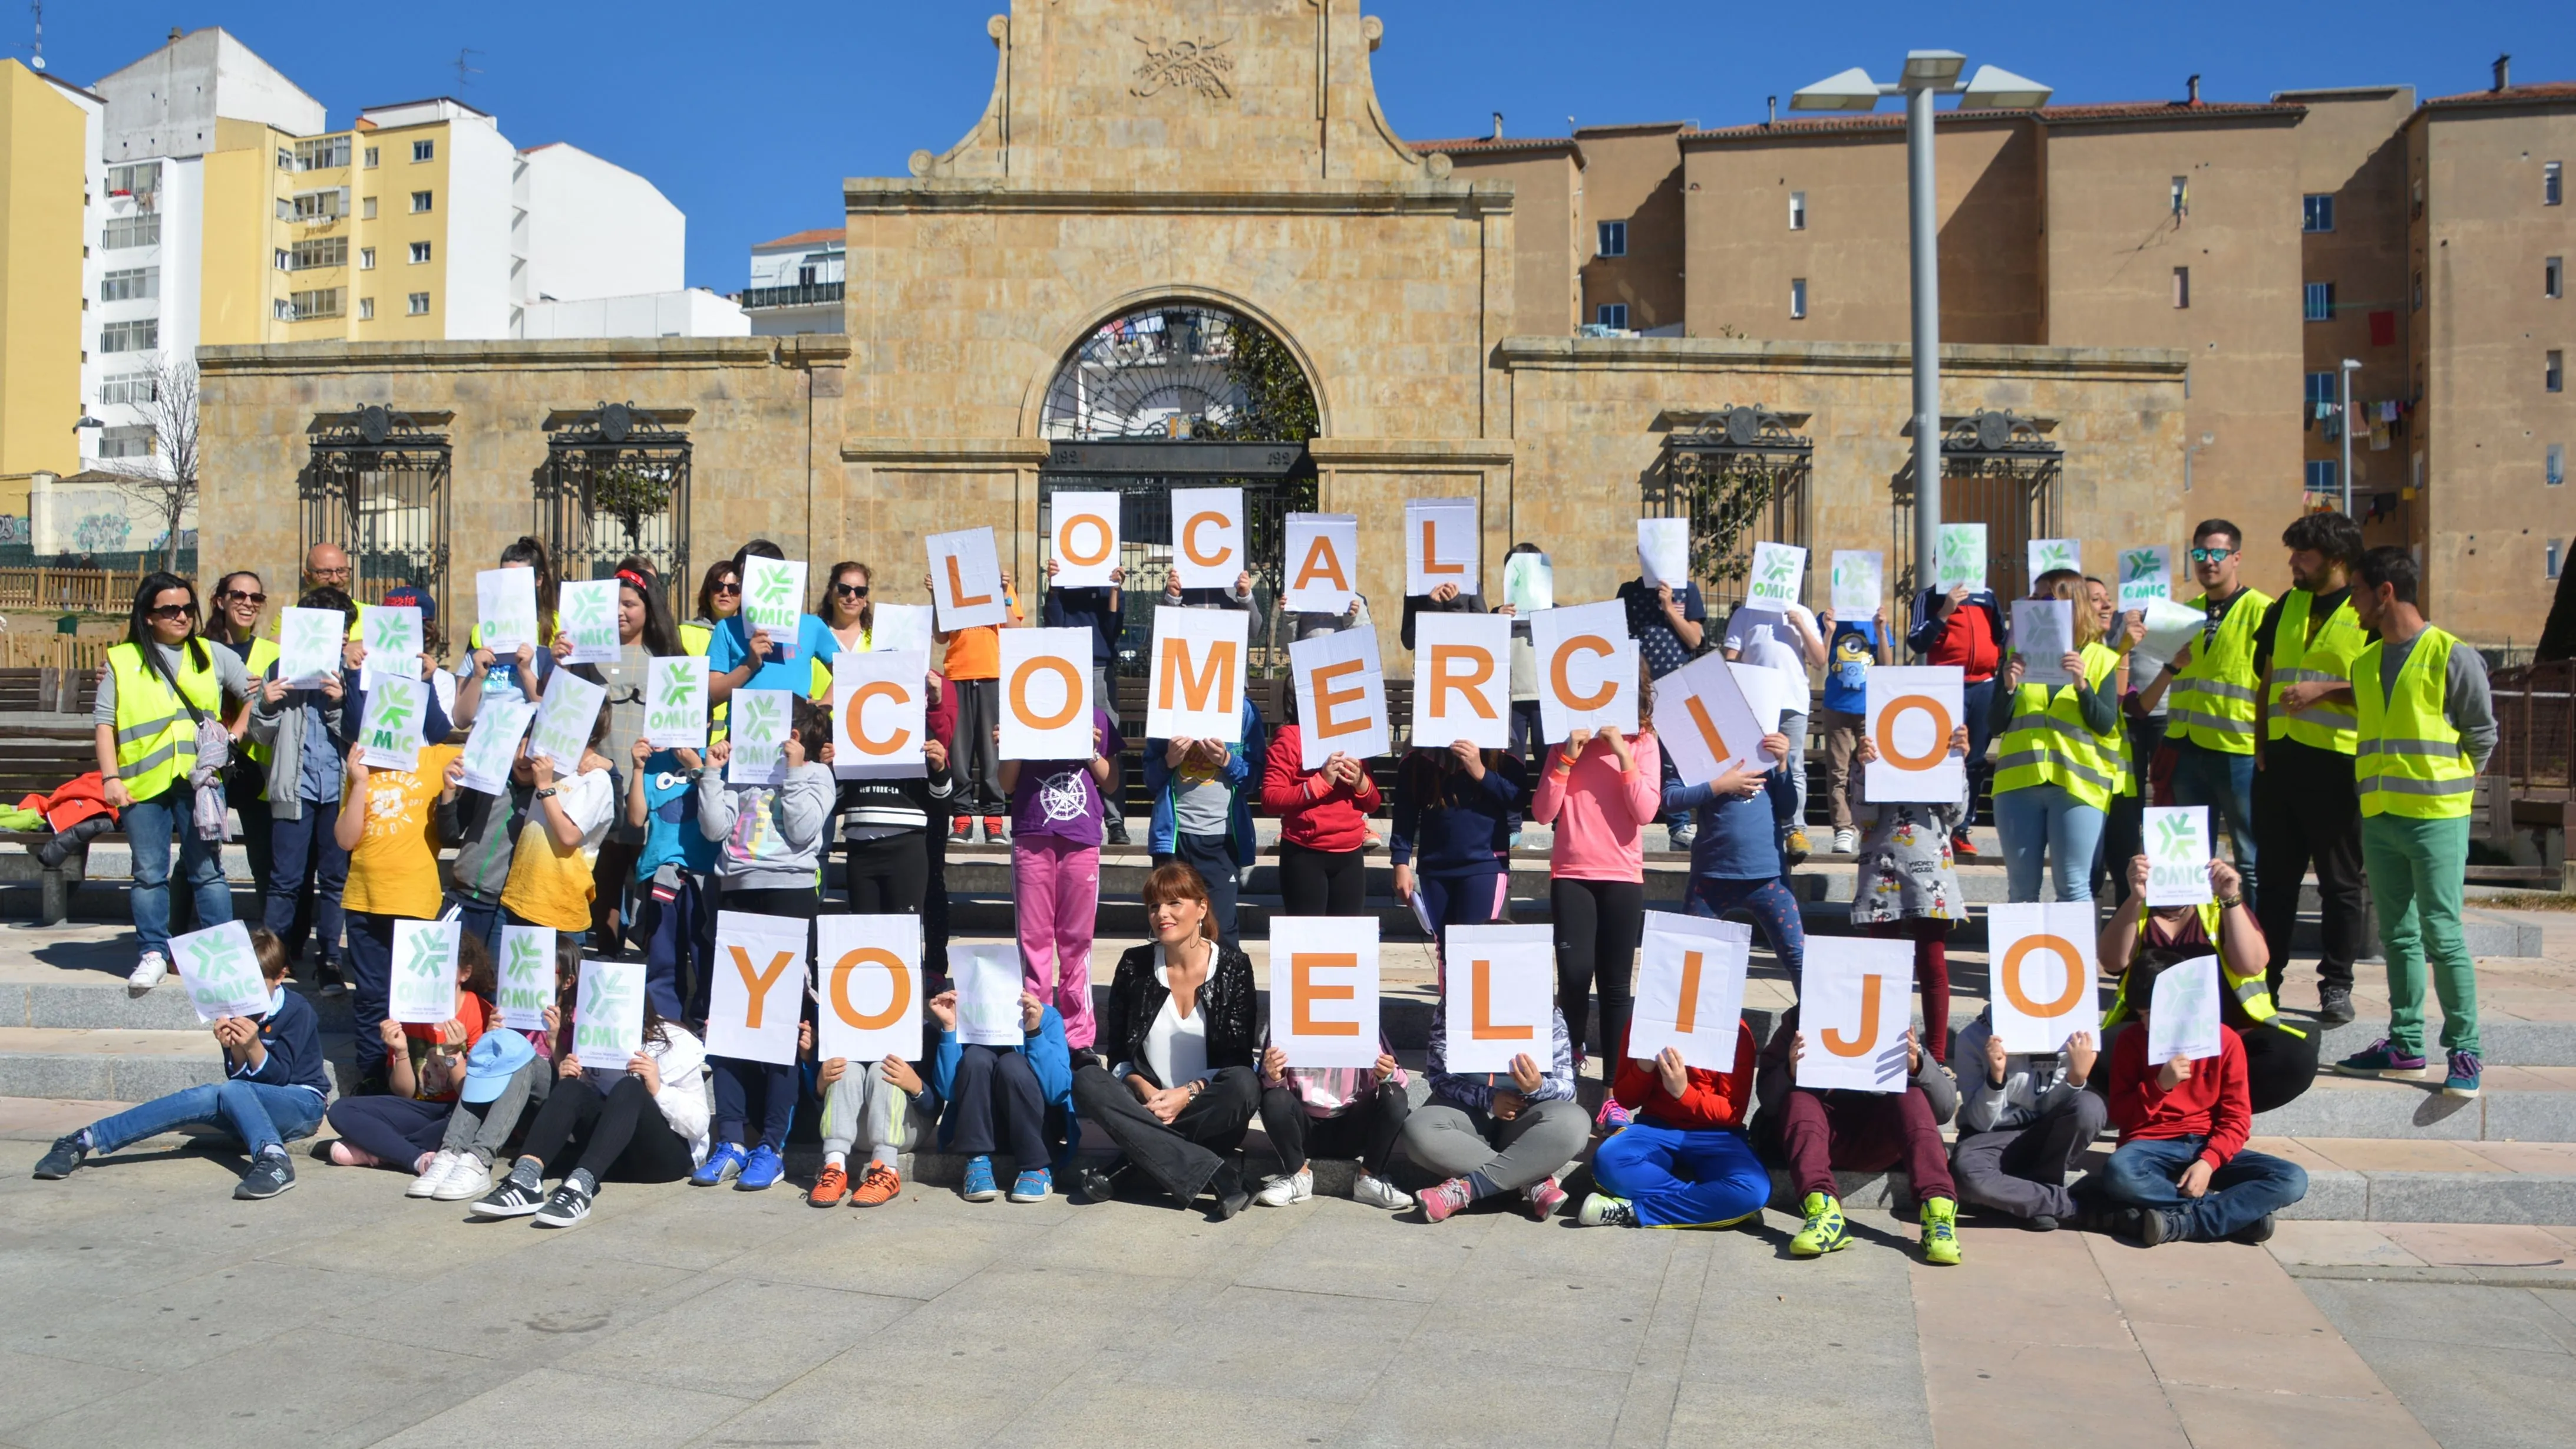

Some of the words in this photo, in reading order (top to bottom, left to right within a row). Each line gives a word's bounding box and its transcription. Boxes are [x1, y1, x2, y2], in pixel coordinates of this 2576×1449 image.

[1059, 513, 1113, 566] O
[1183, 511, 1232, 567] C
[1293, 535, 1349, 590] A
[1422, 520, 1464, 574] L
[946, 555, 992, 608] L
[1752, 582, 1795, 600] OMIC
[2123, 583, 2166, 599] OMIC
[745, 605, 795, 628] OMIC
[1009, 656, 1083, 730] O
[1158, 637, 1237, 714] M
[1311, 659, 1372, 739] E
[1429, 645, 1498, 719] R
[1550, 635, 1619, 711] C
[359, 727, 414, 754] OMIC
[649, 708, 701, 730] OMIC
[846, 681, 911, 755] C
[1685, 694, 1730, 763] I
[1876, 695, 1952, 771] O
[374, 770, 423, 791] LEAGUE
[196, 975, 260, 1005] OMIC
[397, 980, 450, 1004] OMIC
[500, 986, 549, 1011] OMIC
[728, 946, 795, 1029] Y
[830, 948, 911, 1030] O
[1292, 953, 1359, 1036] E
[1472, 960, 1533, 1040] L
[1675, 950, 1703, 1034] I
[2002, 934, 2085, 1018] O
[577, 1023, 635, 1050] OMIC
[1821, 974, 1882, 1058] J
[270, 1167, 287, 1184] N
